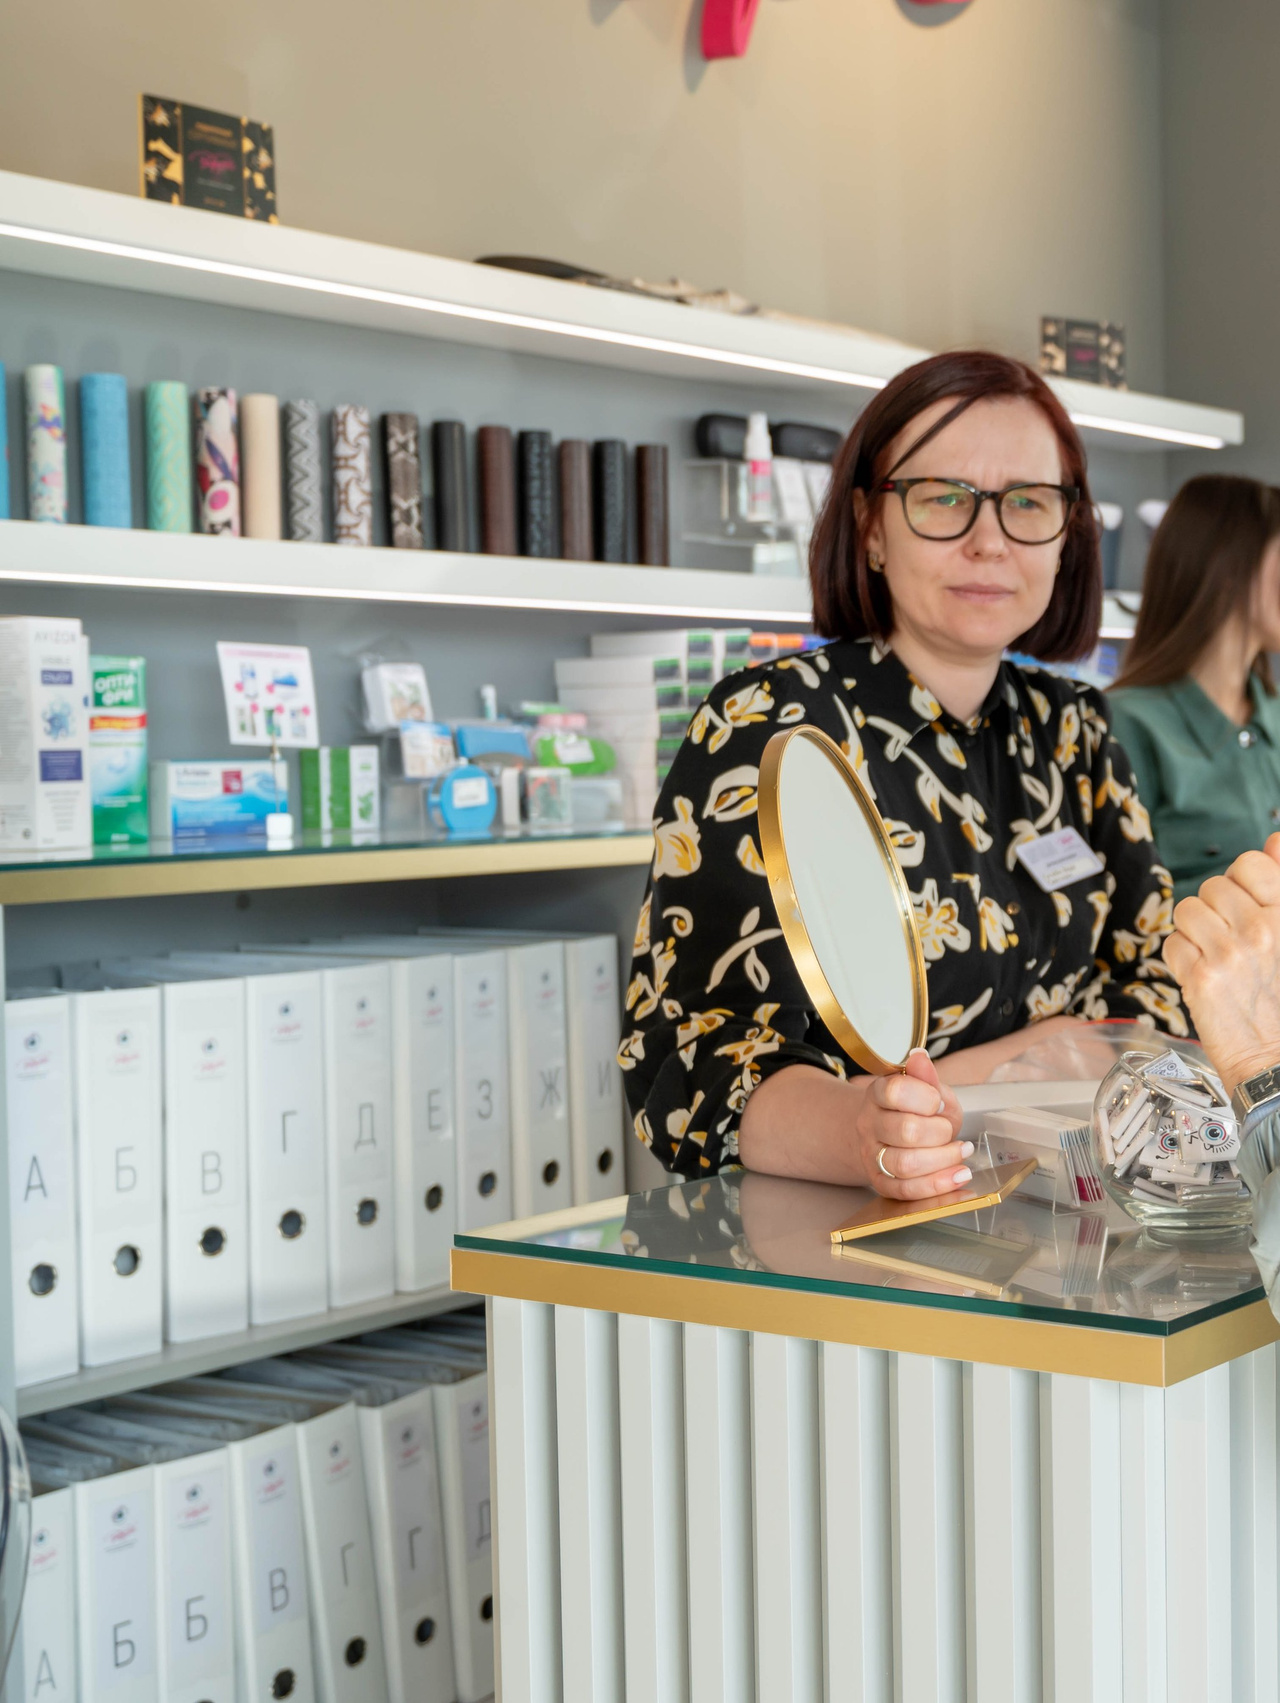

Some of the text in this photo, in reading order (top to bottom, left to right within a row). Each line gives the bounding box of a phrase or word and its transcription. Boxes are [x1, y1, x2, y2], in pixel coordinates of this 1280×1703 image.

[478, 1079, 493, 1119] З
[541, 1067, 562, 1109] Ж
[598, 1062, 611, 1096] И
[282, 1111, 296, 1152] Г
[355, 1103, 376, 1149] Д
[428, 1090, 441, 1131] Е
[25, 1156, 47, 1201] А
[116, 1147, 136, 1192] Б
[202, 1151, 222, 1194] В
[341, 1543, 353, 1586] Г
[409, 1527, 421, 1570] Г
[270, 1568, 289, 1612] В
[186, 1596, 207, 1641] Б
[114, 1620, 135, 1669] Б
[34, 1650, 56, 1696] А
